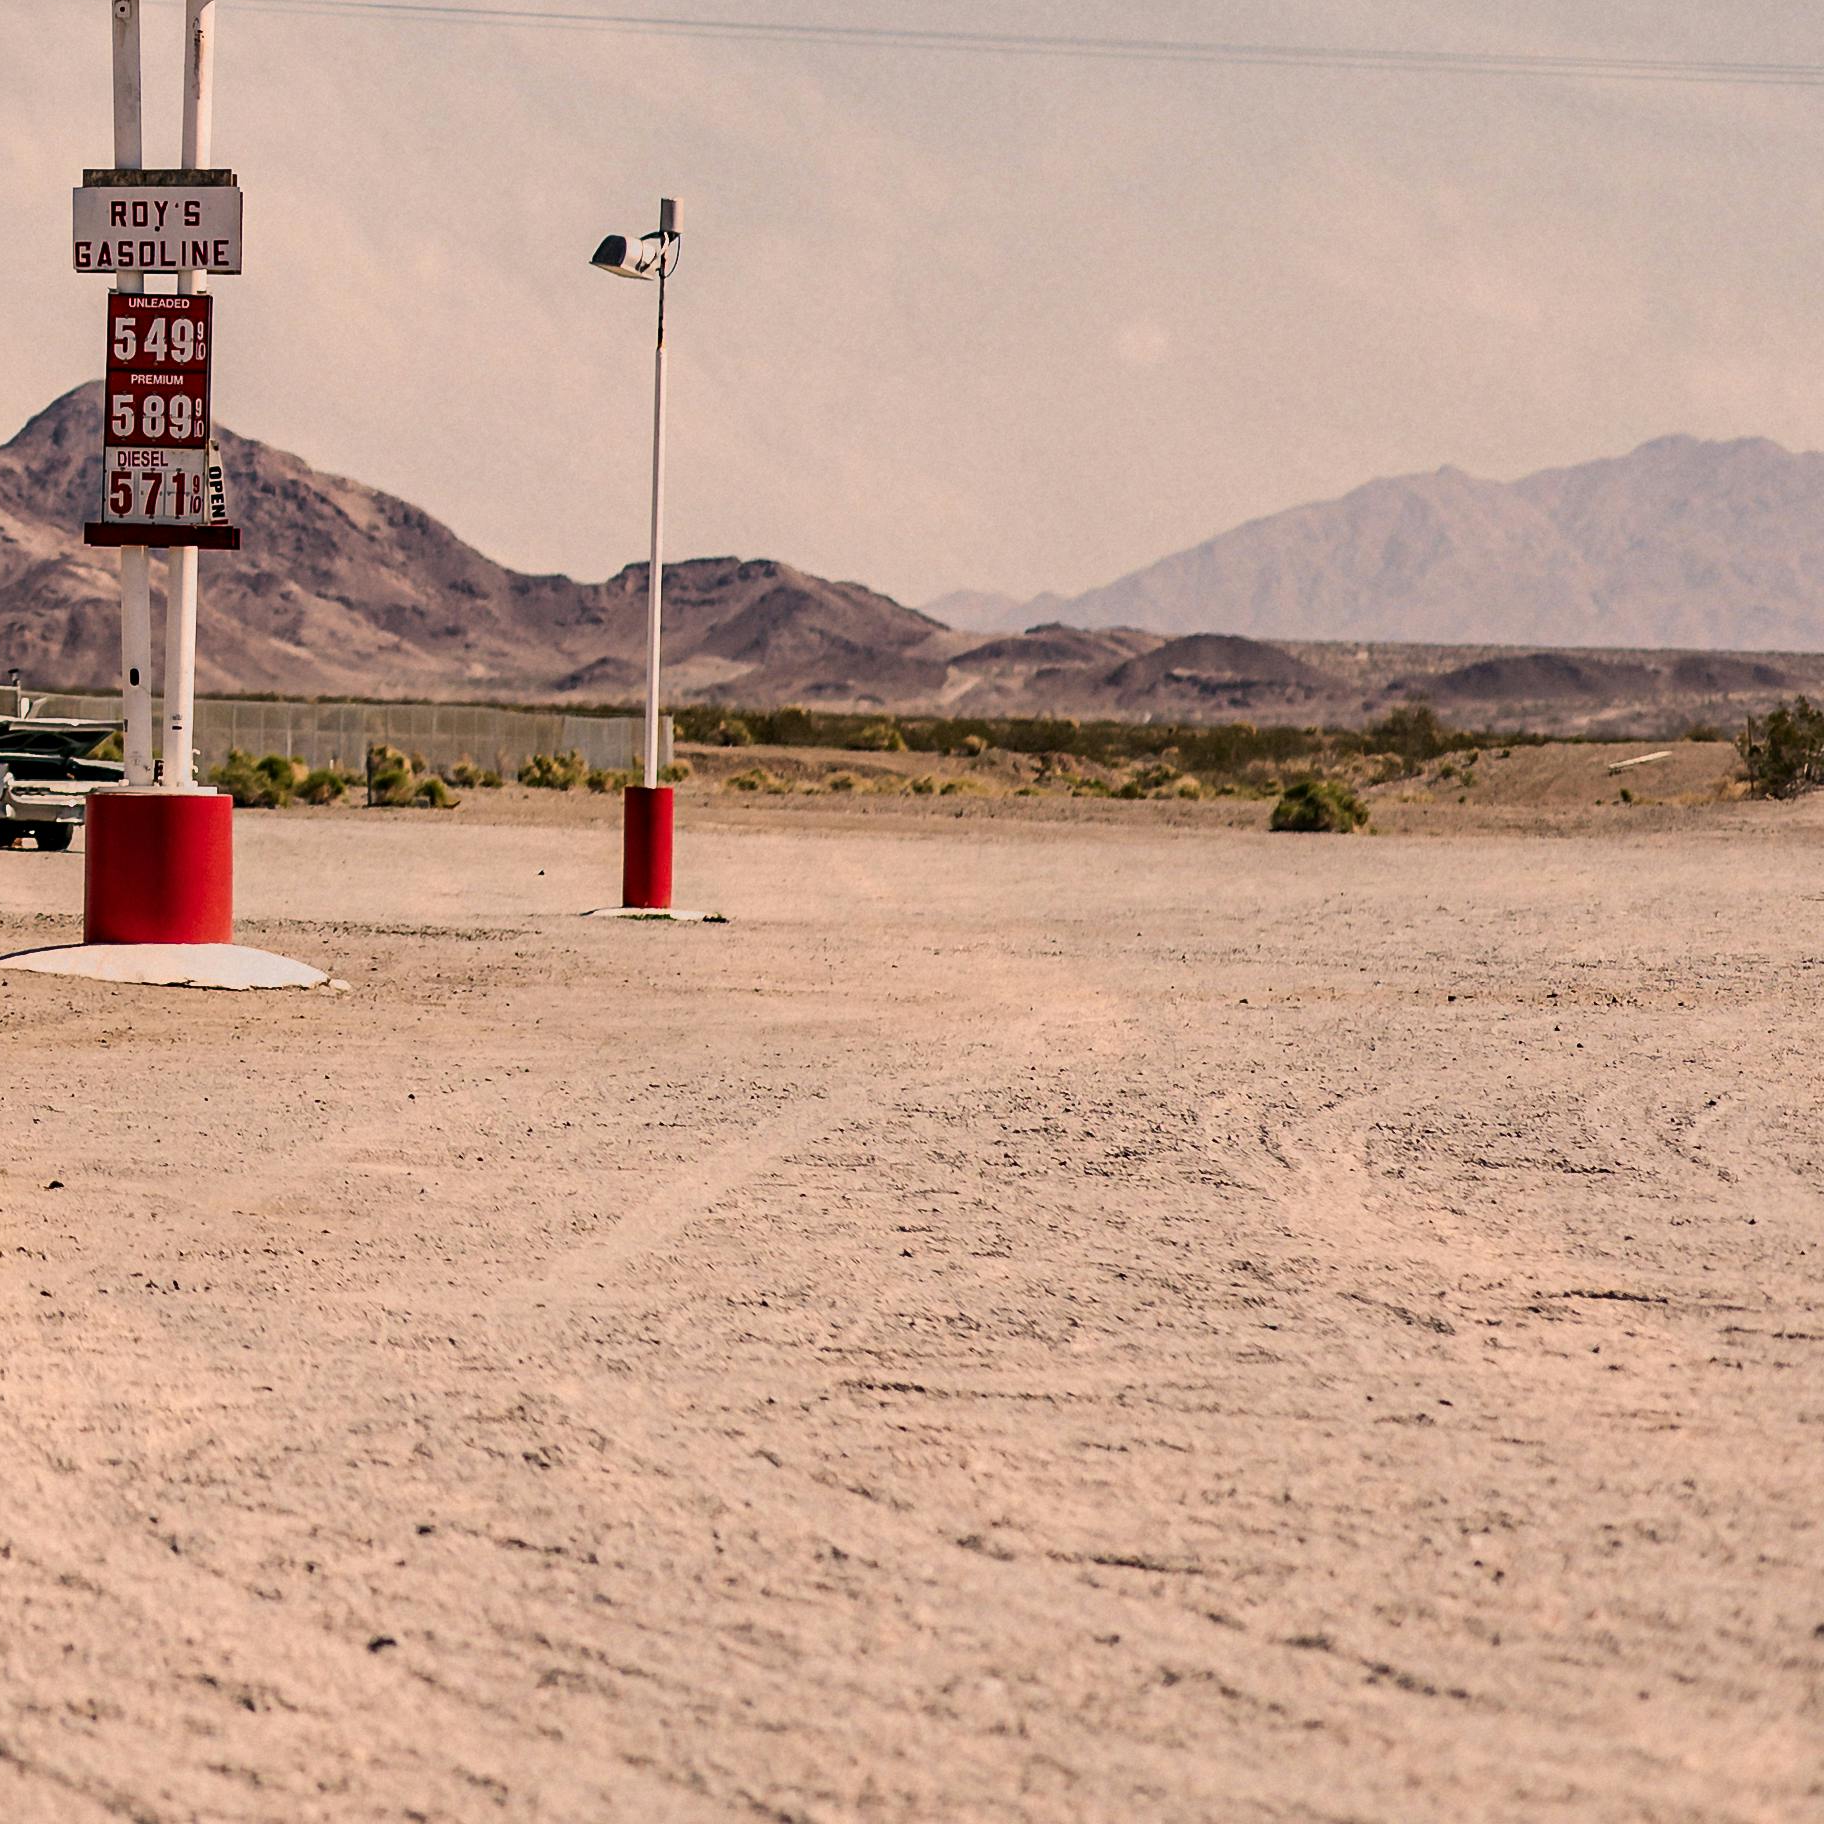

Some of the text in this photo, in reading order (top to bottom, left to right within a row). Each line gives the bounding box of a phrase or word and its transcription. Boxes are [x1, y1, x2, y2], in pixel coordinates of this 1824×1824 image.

[110, 200, 201, 227] ROY'S
[74, 239, 230, 268] GASOLINE
[128, 297, 191, 309] UNLEADED
[113, 317, 194, 363] 549
[130, 374, 184, 385] PREMIUM
[111, 394, 192, 439] 589
[117, 450, 169, 467] DIESEL
[109, 470, 186, 516] 571
[208, 465, 225, 518] OPEN
